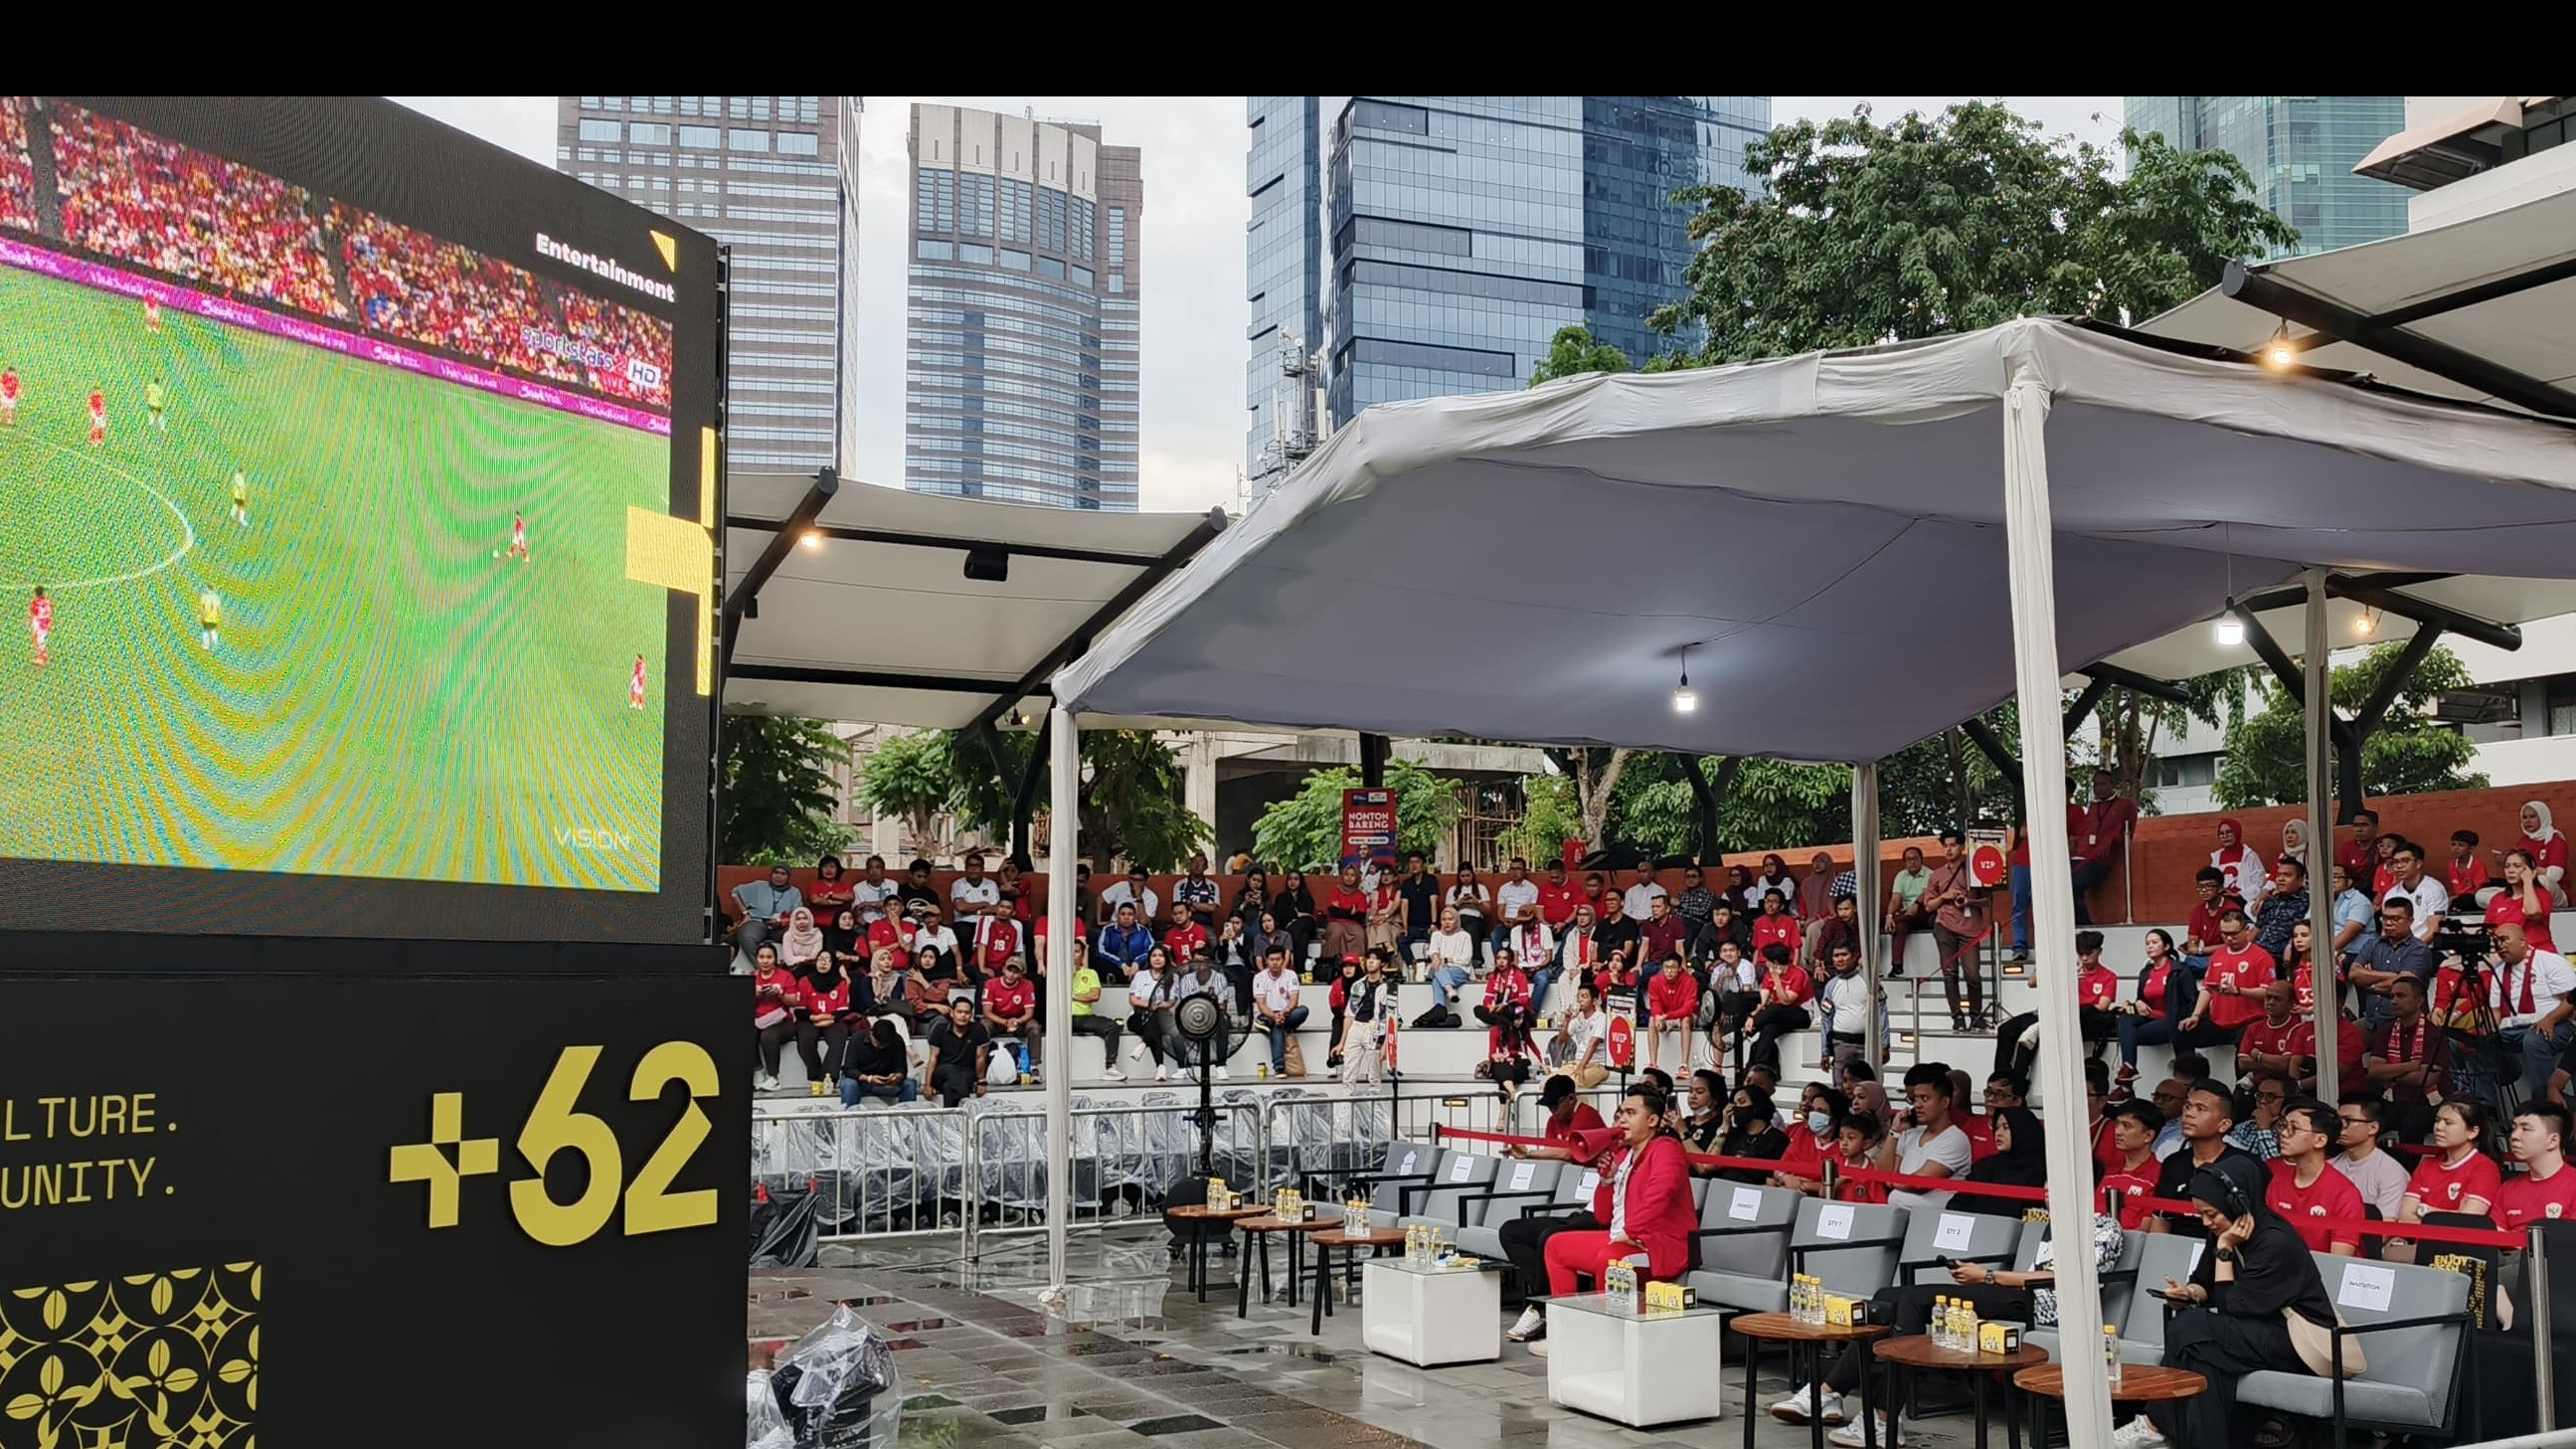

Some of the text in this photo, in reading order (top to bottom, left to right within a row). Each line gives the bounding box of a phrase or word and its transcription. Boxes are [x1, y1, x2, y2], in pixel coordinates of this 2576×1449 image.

[536, 232, 677, 303] Entertainment
[630, 363, 657, 385] HD
[1348, 812, 1389, 820] NONTON
[1348, 820, 1389, 829] BARENG
[1979, 860, 1996, 869] VIP
[817, 999, 826, 1013] 4
[1611, 1031, 1628, 1043] VIP
[390, 1040, 721, 1246] +62
[2434, 1253, 2470, 1266] ENJOY
